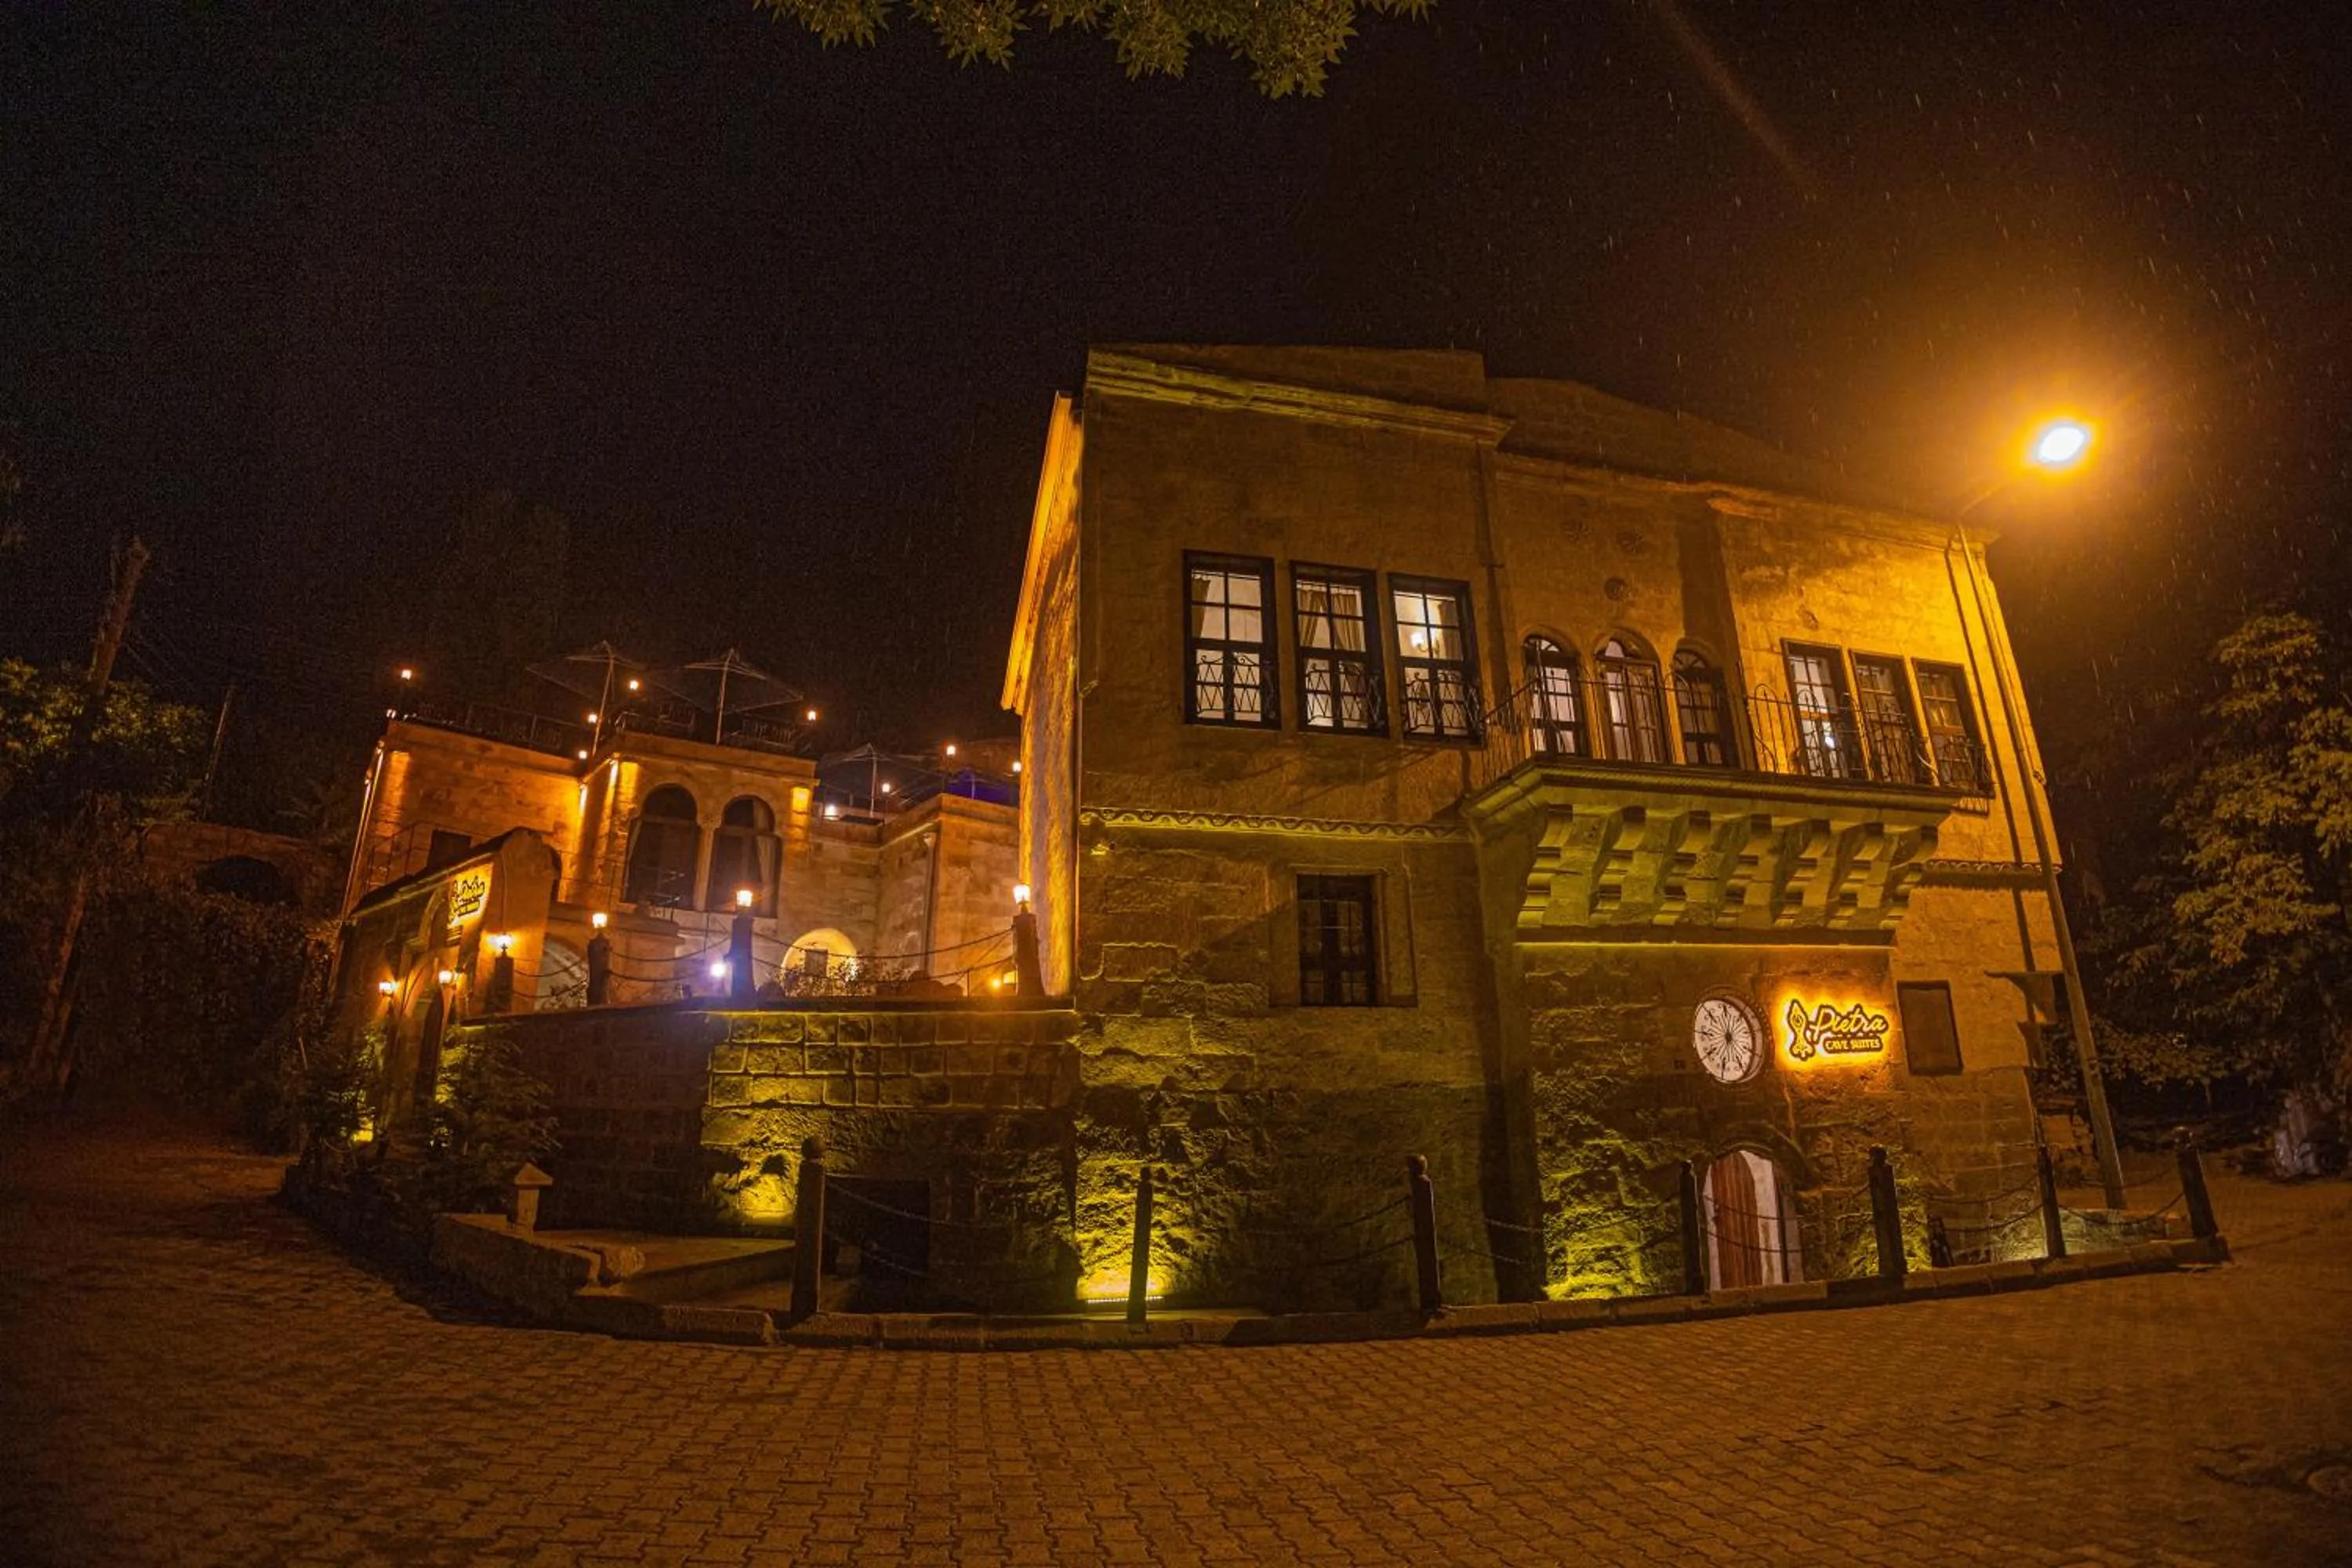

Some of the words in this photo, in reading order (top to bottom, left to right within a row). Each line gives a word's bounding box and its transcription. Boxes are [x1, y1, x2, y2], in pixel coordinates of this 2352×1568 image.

[1809, 1006, 1887, 1042] Pietra
[1824, 1040, 1849, 1051] CAVE
[1850, 1038, 1881, 1050] SUITES
